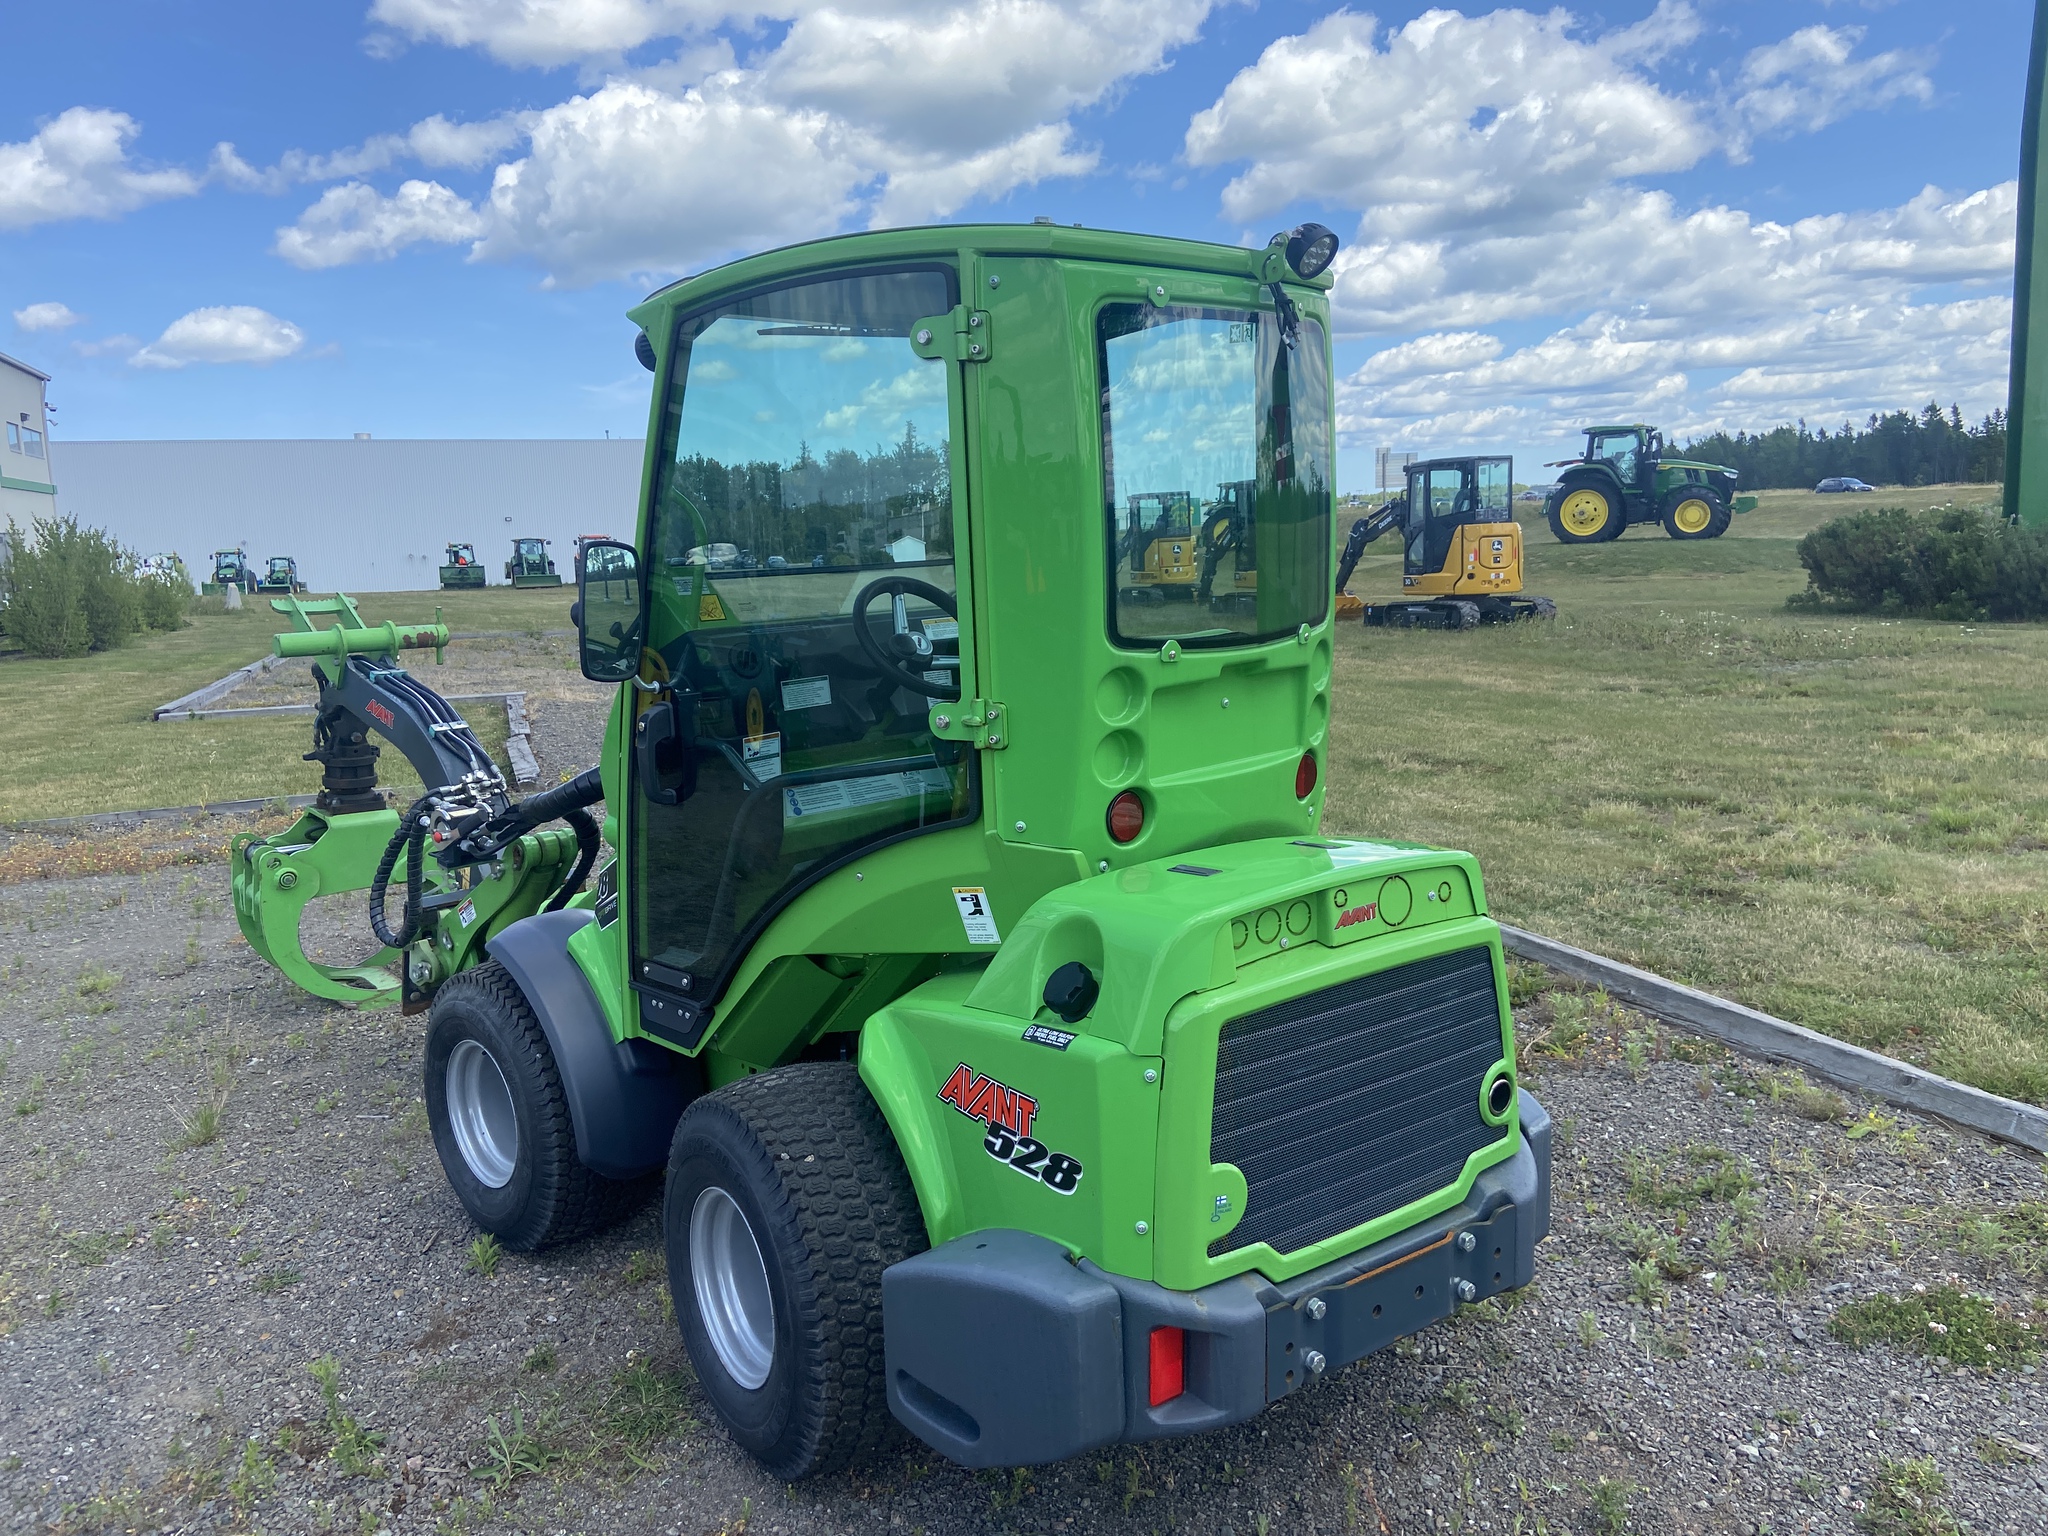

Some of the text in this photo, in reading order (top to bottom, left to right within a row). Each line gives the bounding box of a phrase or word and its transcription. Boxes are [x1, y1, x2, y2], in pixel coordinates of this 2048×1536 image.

[365, 698, 395, 730] AVANT
[1334, 902, 1377, 930] AVANT
[937, 1062, 1038, 1137] AVANT
[983, 1120, 1083, 1196] 528
